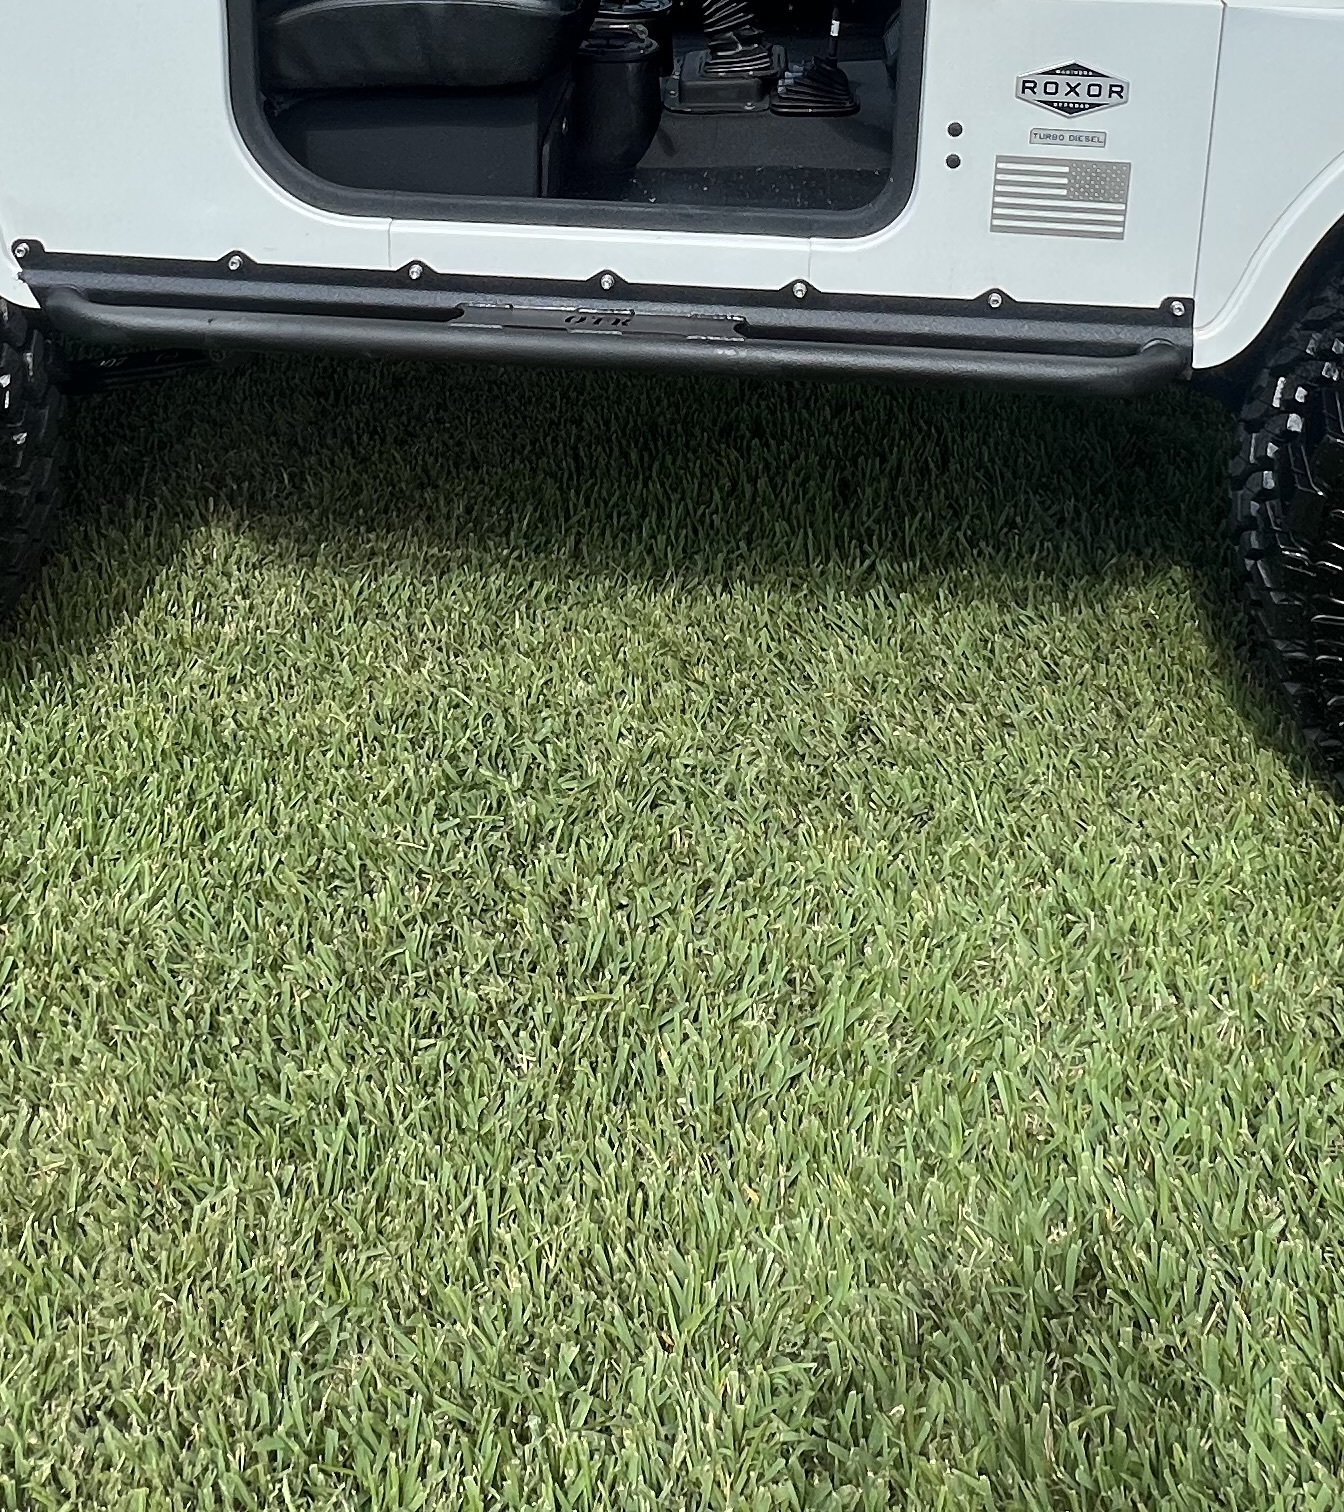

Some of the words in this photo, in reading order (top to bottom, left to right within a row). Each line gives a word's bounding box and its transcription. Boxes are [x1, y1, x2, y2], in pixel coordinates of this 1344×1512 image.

[1021, 79, 1124, 99] ROXOR
[1033, 132, 1065, 142] TURBO
[1068, 134, 1104, 144] DIESEL
